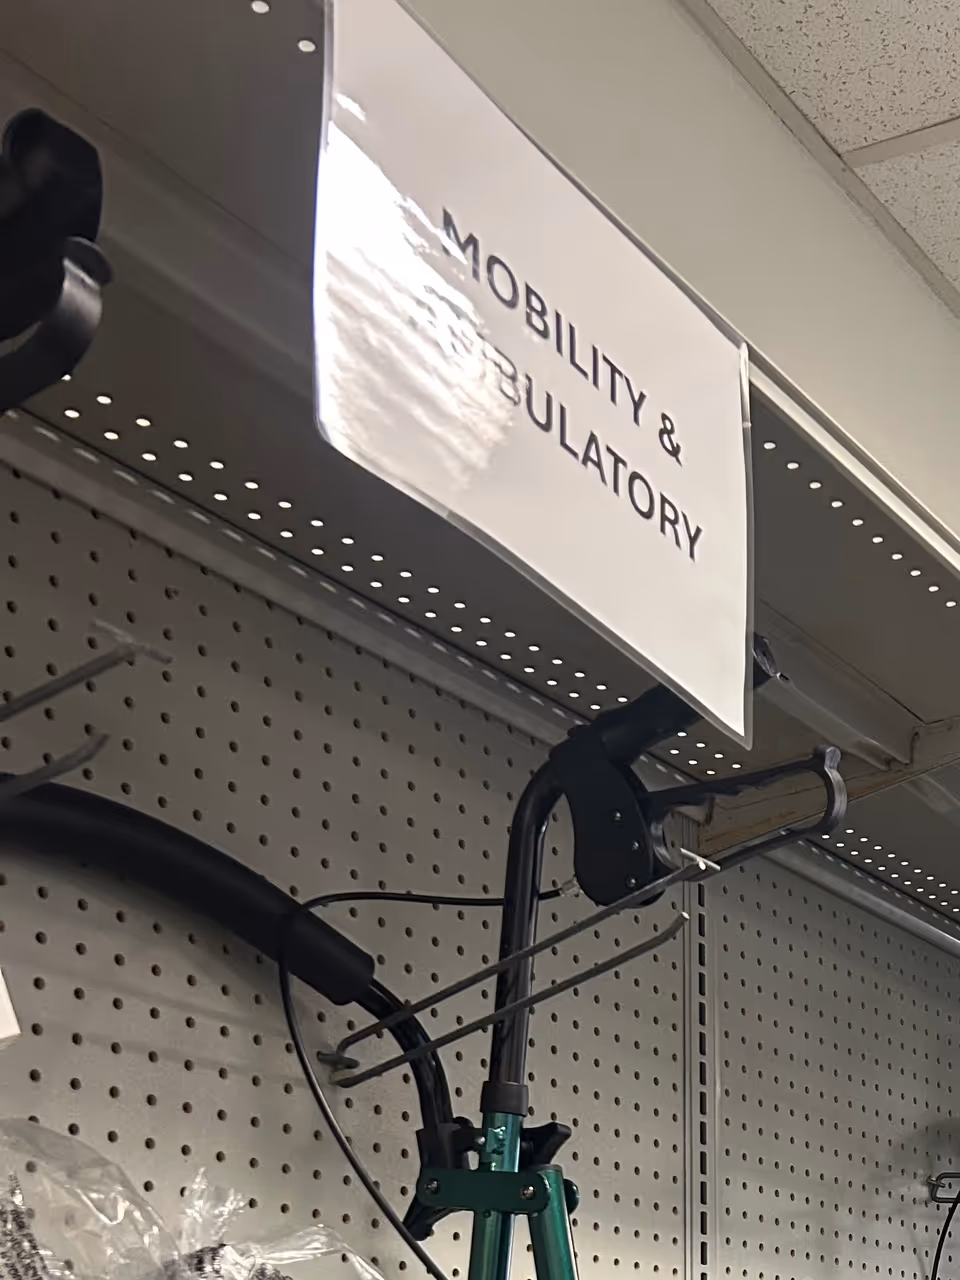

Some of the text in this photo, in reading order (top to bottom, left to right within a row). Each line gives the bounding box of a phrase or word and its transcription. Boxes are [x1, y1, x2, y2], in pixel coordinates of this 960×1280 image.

[441, 207, 683, 466] MOBILITY &
[445, 315, 703, 562] BULATORY
